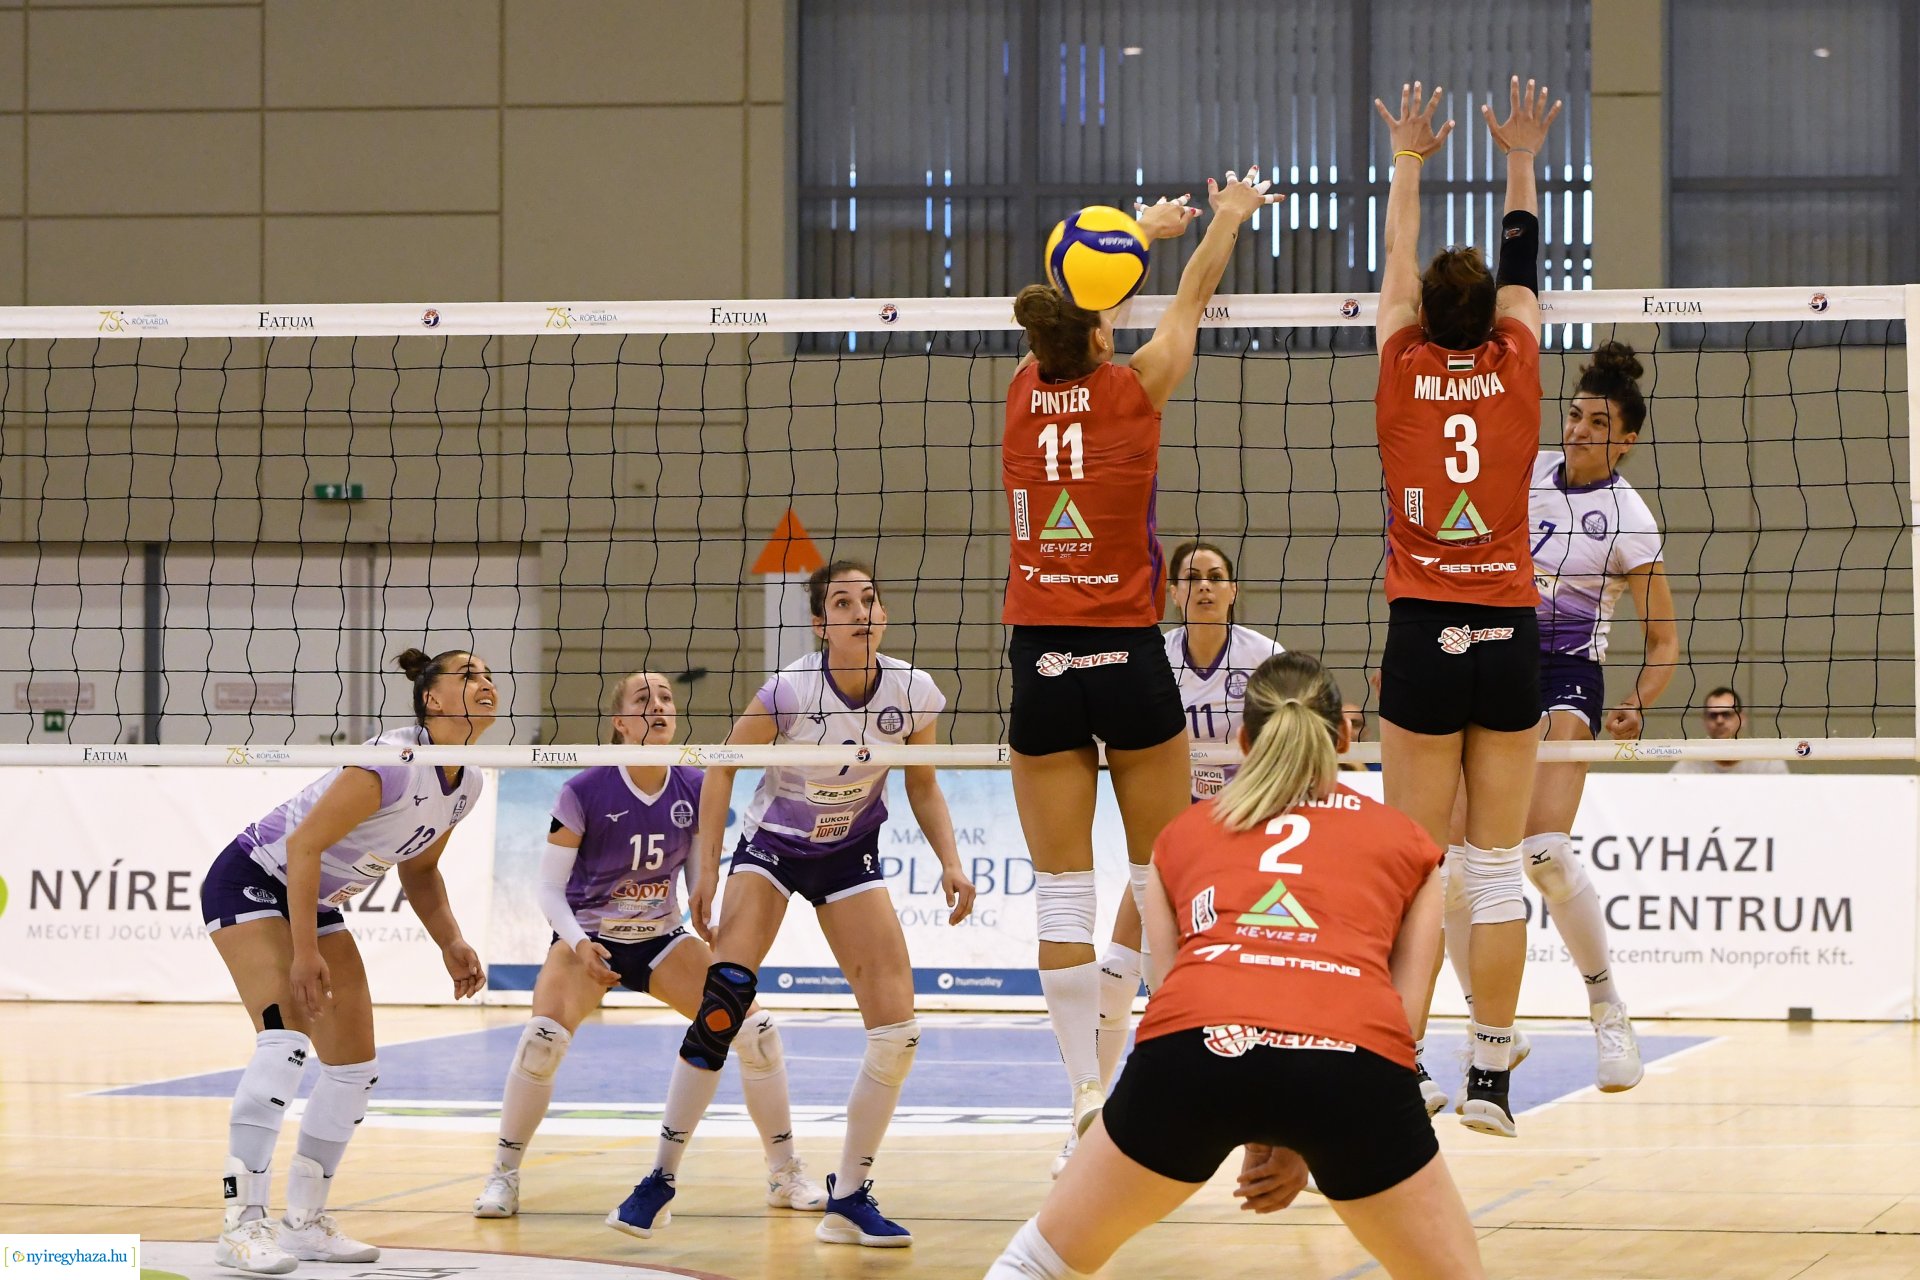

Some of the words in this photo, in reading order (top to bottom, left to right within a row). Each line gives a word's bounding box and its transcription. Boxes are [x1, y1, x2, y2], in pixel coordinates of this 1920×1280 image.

[1414, 371, 1505, 400] MILANOVA
[1031, 385, 1091, 414] PINTÉR
[1038, 422, 1085, 481] 11
[1444, 413, 1480, 484] 3
[1017, 491, 1026, 538] STRABAG
[1040, 543, 1077, 553] KE-VIZ
[1079, 542, 1092, 552] 21
[1039, 574, 1119, 585] BESTRONG
[1439, 562, 1517, 573] BESTRONG
[1185, 703, 1216, 738] 11
[1193, 769, 1223, 779] LUKOIL
[820, 815, 850, 824] LUKOIL
[395, 825, 436, 856] 13
[629, 833, 665, 872] 15
[1259, 814, 1311, 875] 2
[27, 924, 100, 941] MEGYEI
[109, 921, 162, 941] JOGÚ
[1236, 926, 1295, 941] KE-VIZ
[1297, 932, 1317, 943] 21
[1239, 953, 1361, 977] BESTRONG
[1710, 945, 1812, 968] Nonprofit
[1818, 946, 1854, 966] Kft.
